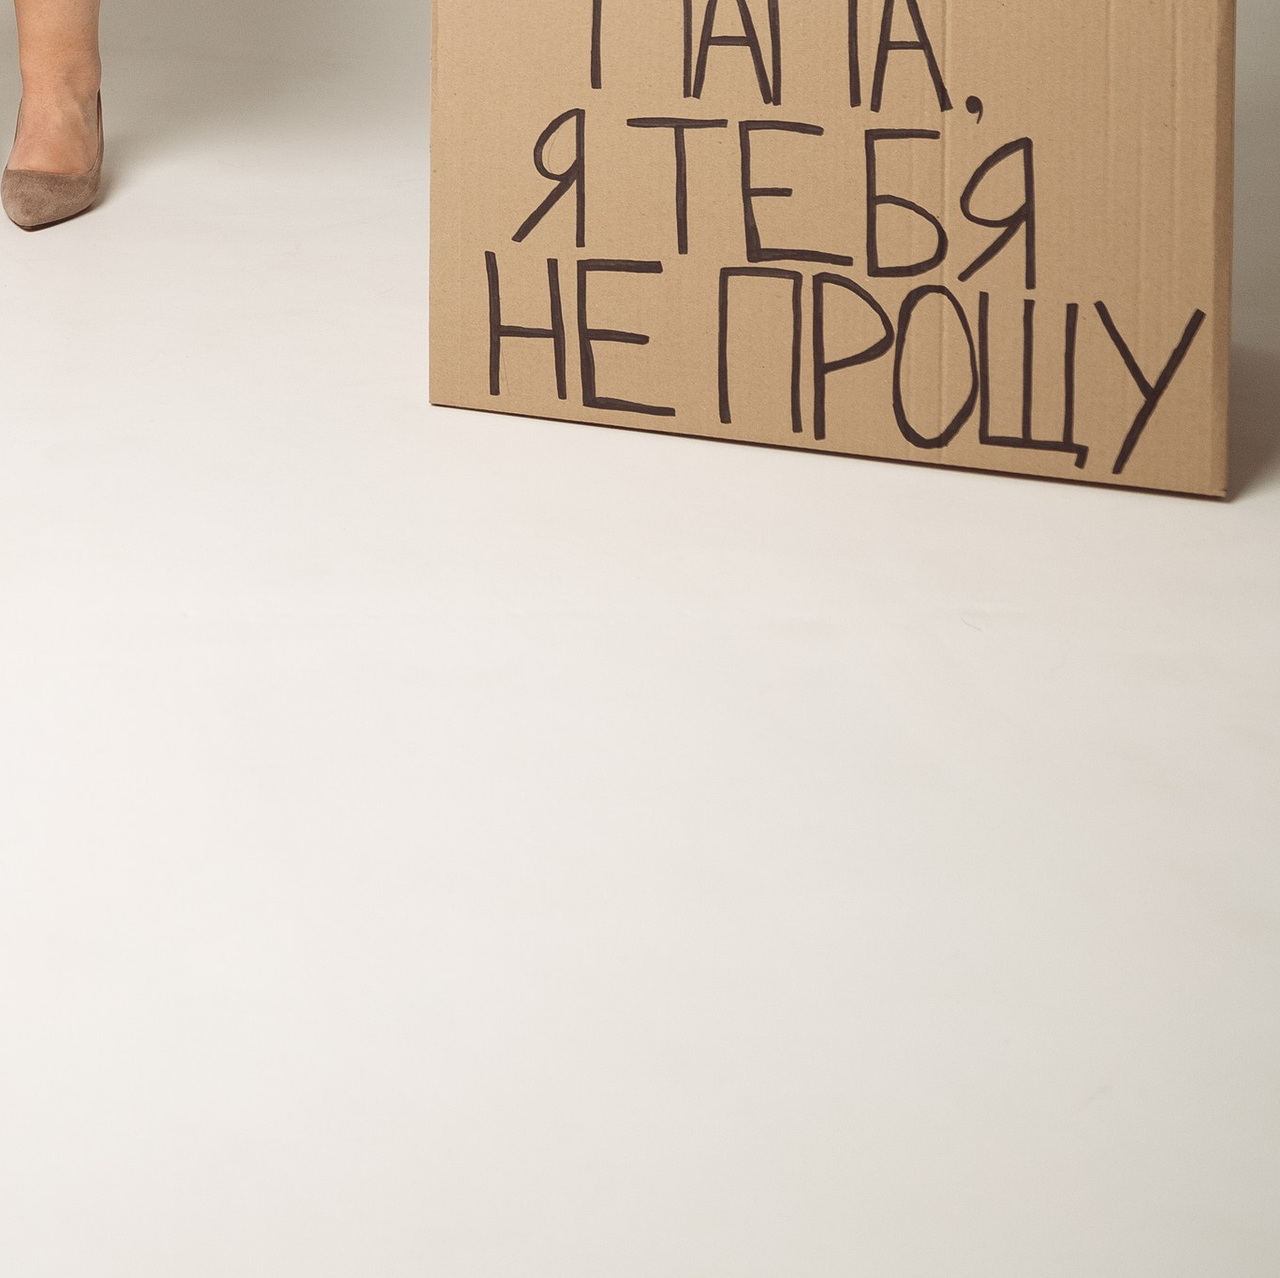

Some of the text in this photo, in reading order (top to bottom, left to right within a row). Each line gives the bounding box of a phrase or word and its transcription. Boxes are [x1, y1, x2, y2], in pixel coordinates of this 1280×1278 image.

[512, 108, 1036, 290] Я ТЕБЯ
[485, 251, 1206, 475] НЕ ПРОЩУ
